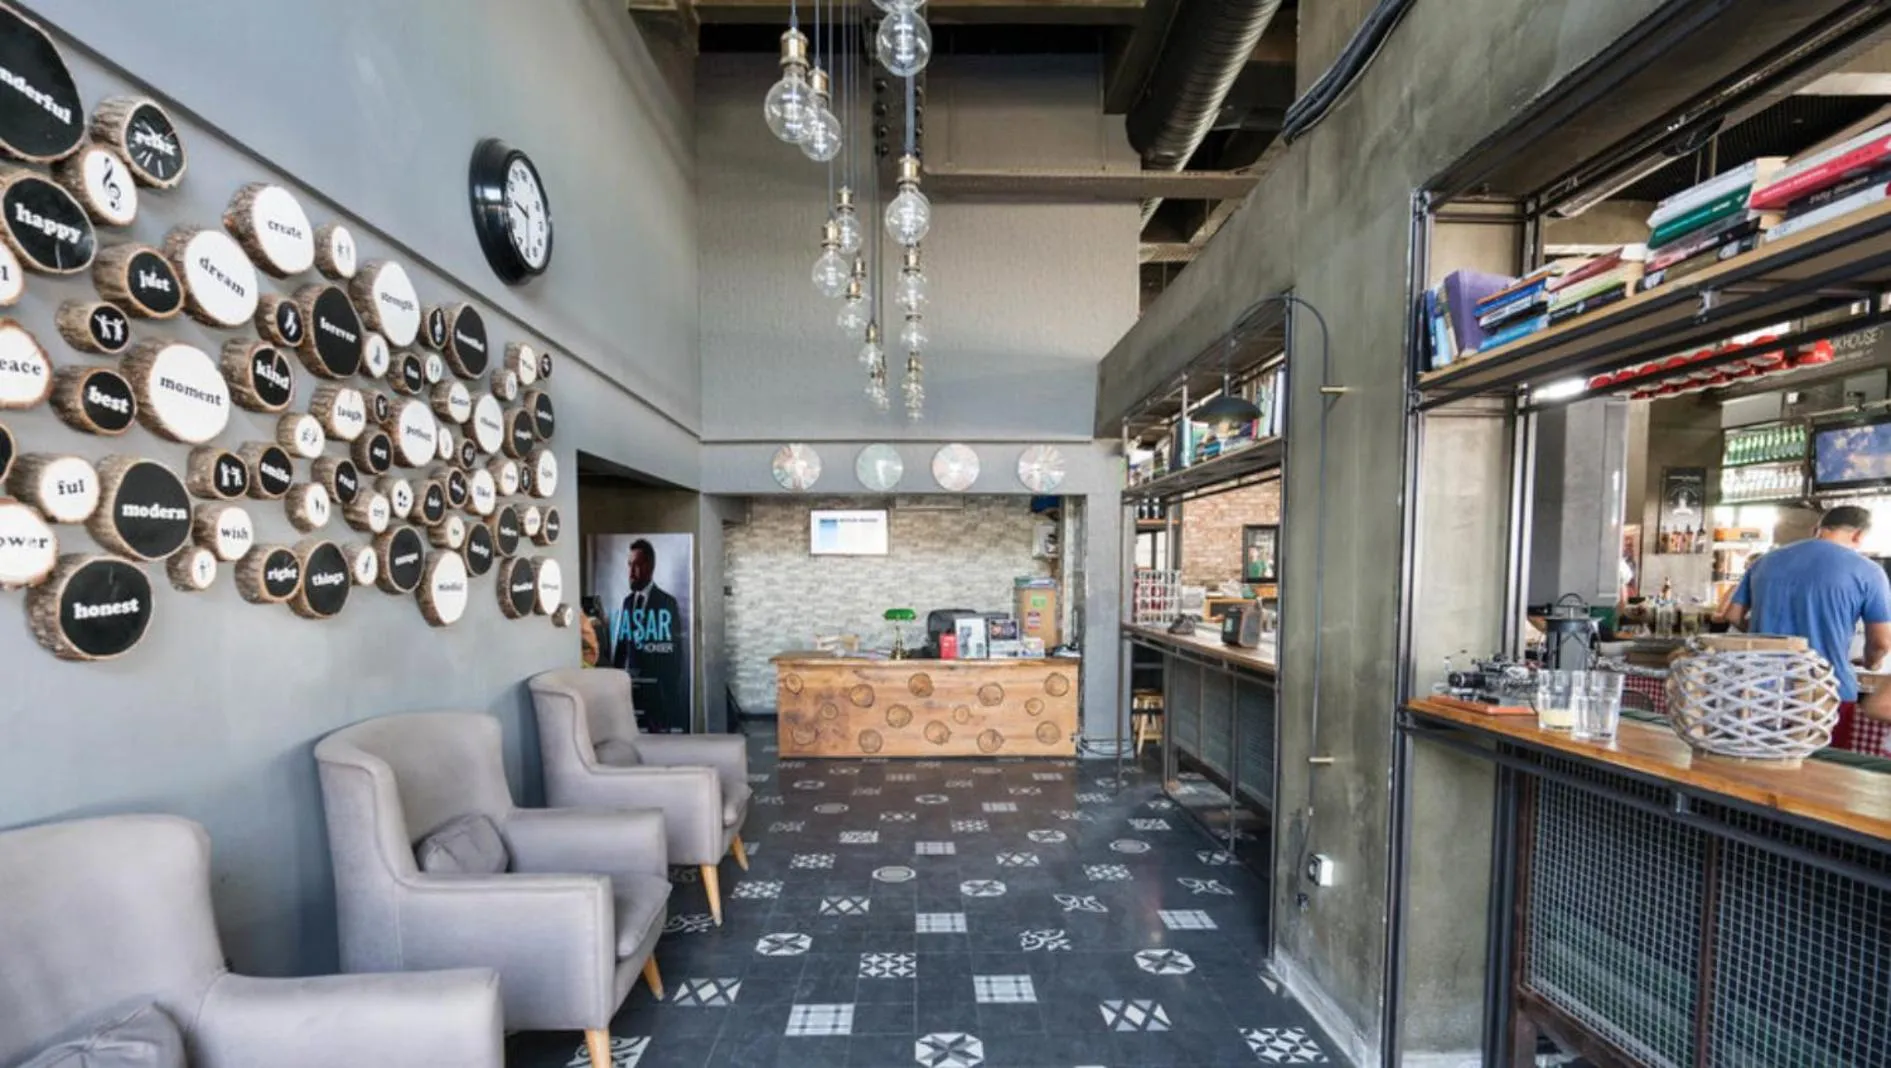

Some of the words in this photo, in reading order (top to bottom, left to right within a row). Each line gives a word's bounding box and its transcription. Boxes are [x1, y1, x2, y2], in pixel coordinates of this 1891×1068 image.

[15, 203, 81, 244] happy
[268, 218, 302, 240] create
[139, 270, 170, 292] just
[199, 255, 245, 298] dream
[256, 360, 289, 389] kind
[88, 386, 129, 413] best
[159, 375, 222, 406] moment
[337, 405, 362, 423] laugh
[58, 478, 85, 495] ful
[122, 503, 188, 520] modern
[221, 526, 249, 541] wish
[267, 566, 297, 582] right
[312, 570, 344, 587] things
[74, 598, 140, 619] honest
